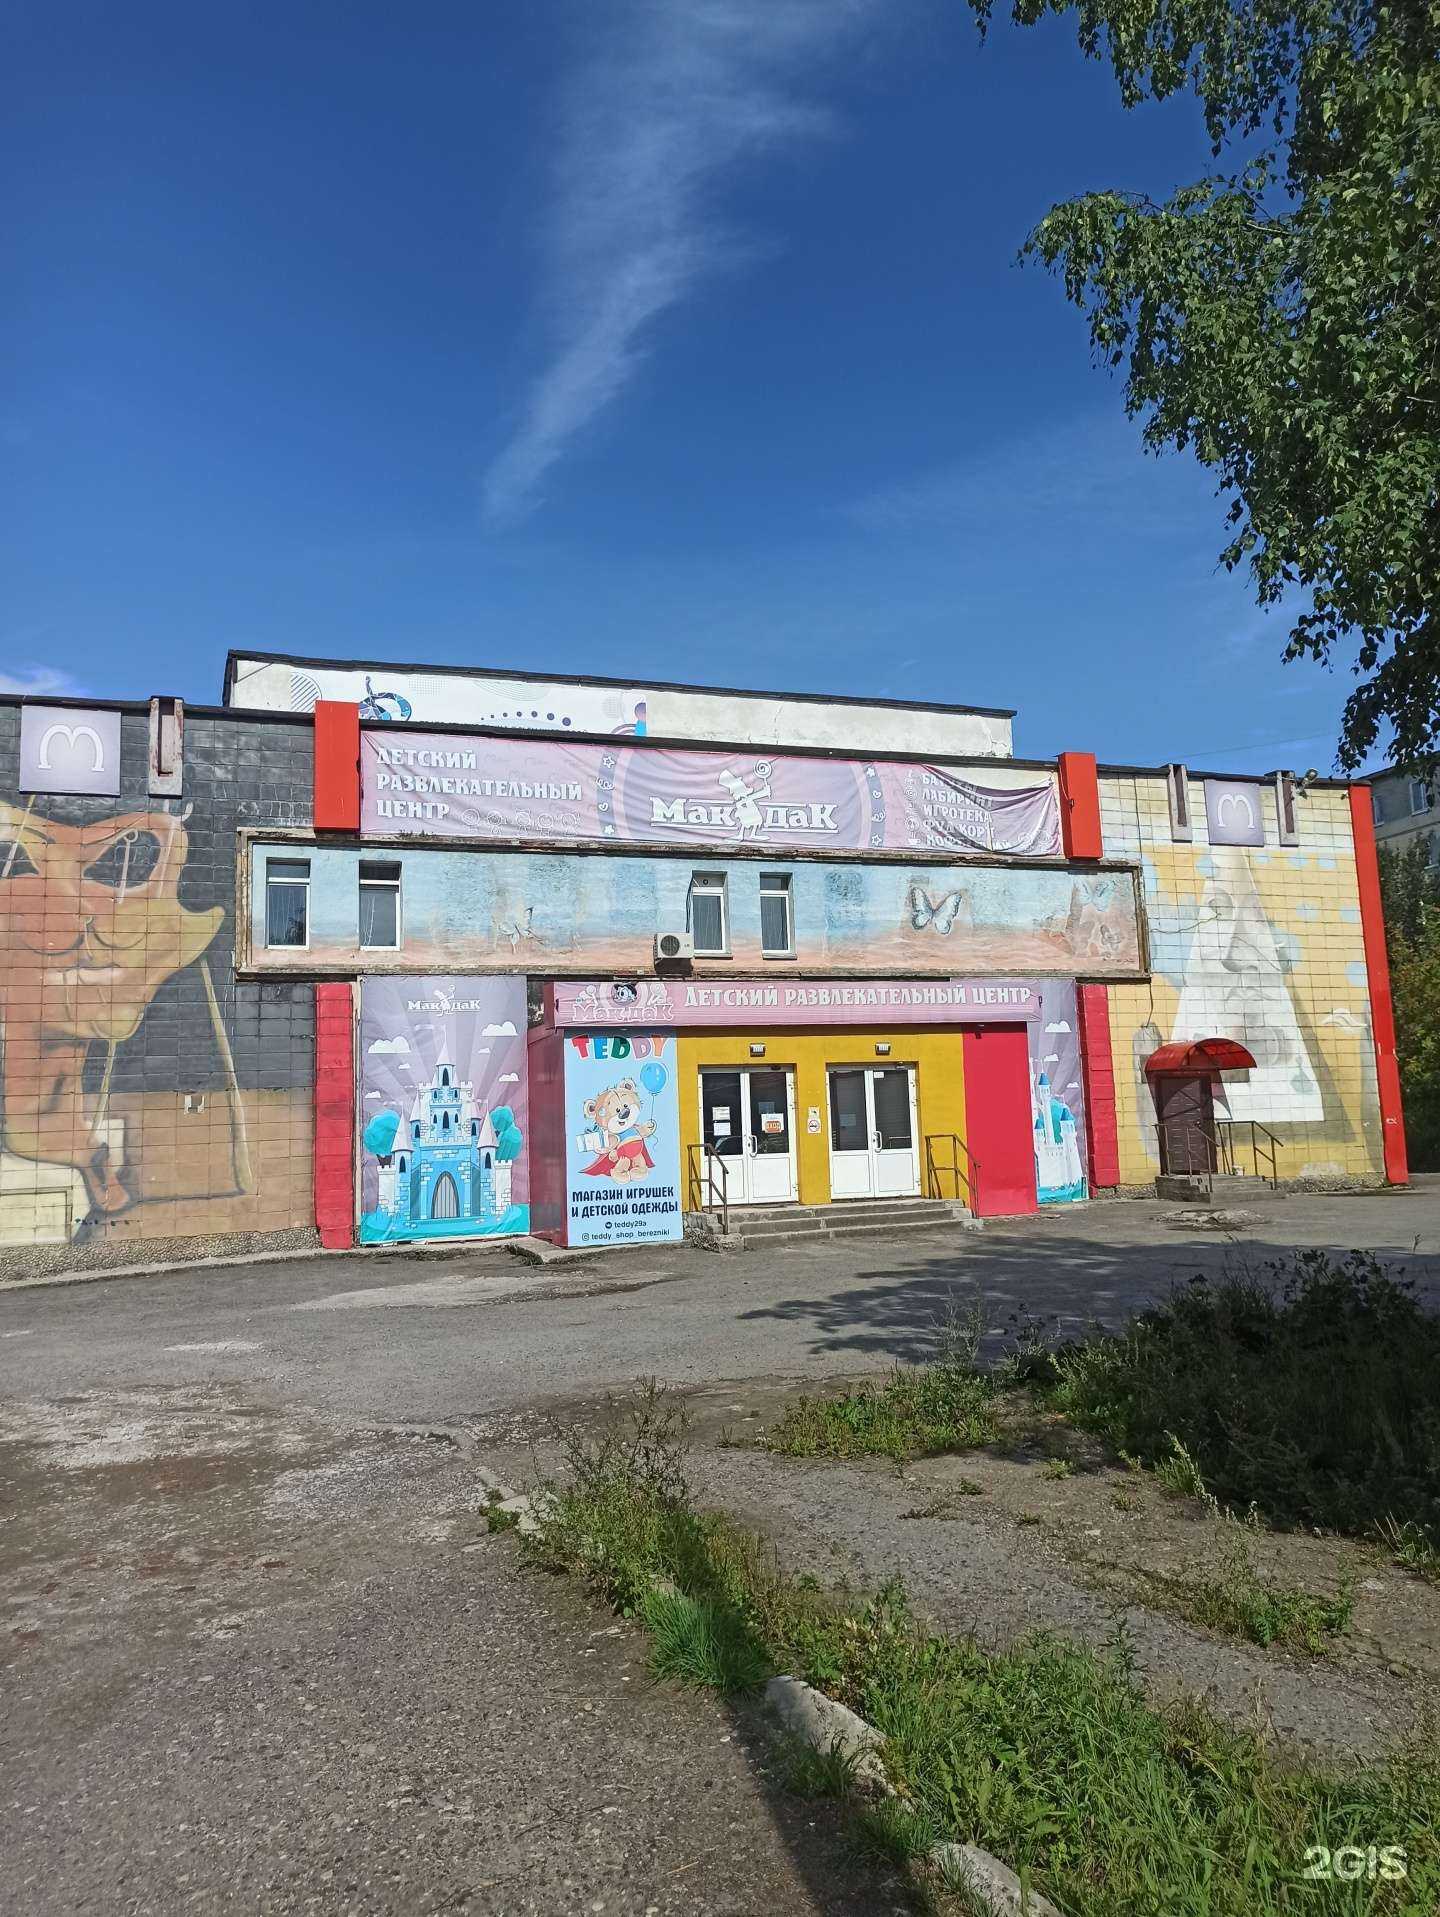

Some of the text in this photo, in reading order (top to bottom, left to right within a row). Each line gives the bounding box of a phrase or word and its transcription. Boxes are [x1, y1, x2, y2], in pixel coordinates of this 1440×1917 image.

[376, 747, 477, 770] ДЕТСКИЙ
[376, 773, 583, 801] РАЗВЛЕКАТЕЛЬНЫЙ
[376, 799, 450, 819] ЦЕНТР
[923, 804, 992, 823] ИГРОТЕКА
[684, 986, 778, 1007] ДЕТСКИЙ
[784, 984, 966, 1006] РАЗВЛЕКАТЕЛЬНЫЙ
[971, 986, 1031, 1006] ЦЕНТР
[571, 1034, 669, 1060] TEDDY
[572, 1186, 674, 1203] МАГАЗИН ИГРУШЕК
[571, 1201, 678, 1218] И ДЕТСКОЙ ОДЕЖДЫ
